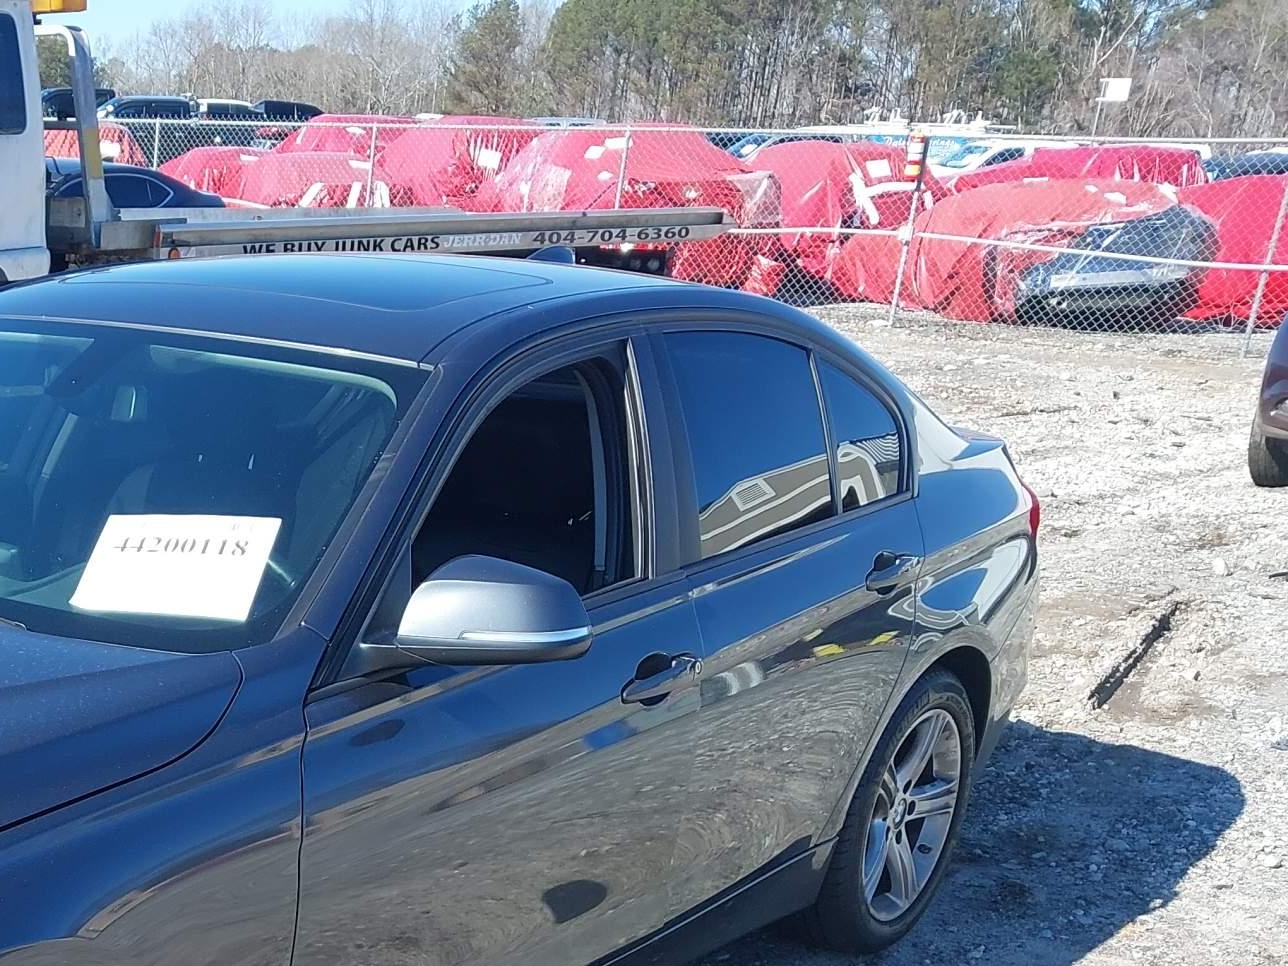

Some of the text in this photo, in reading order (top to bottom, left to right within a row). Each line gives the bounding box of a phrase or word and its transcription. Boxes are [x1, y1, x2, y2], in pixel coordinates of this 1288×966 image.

[242, 236, 441, 254] WE BUY JUNK CARS
[532, 226, 691, 246] 404-704-6360
[112, 536, 250, 556] 44200118
